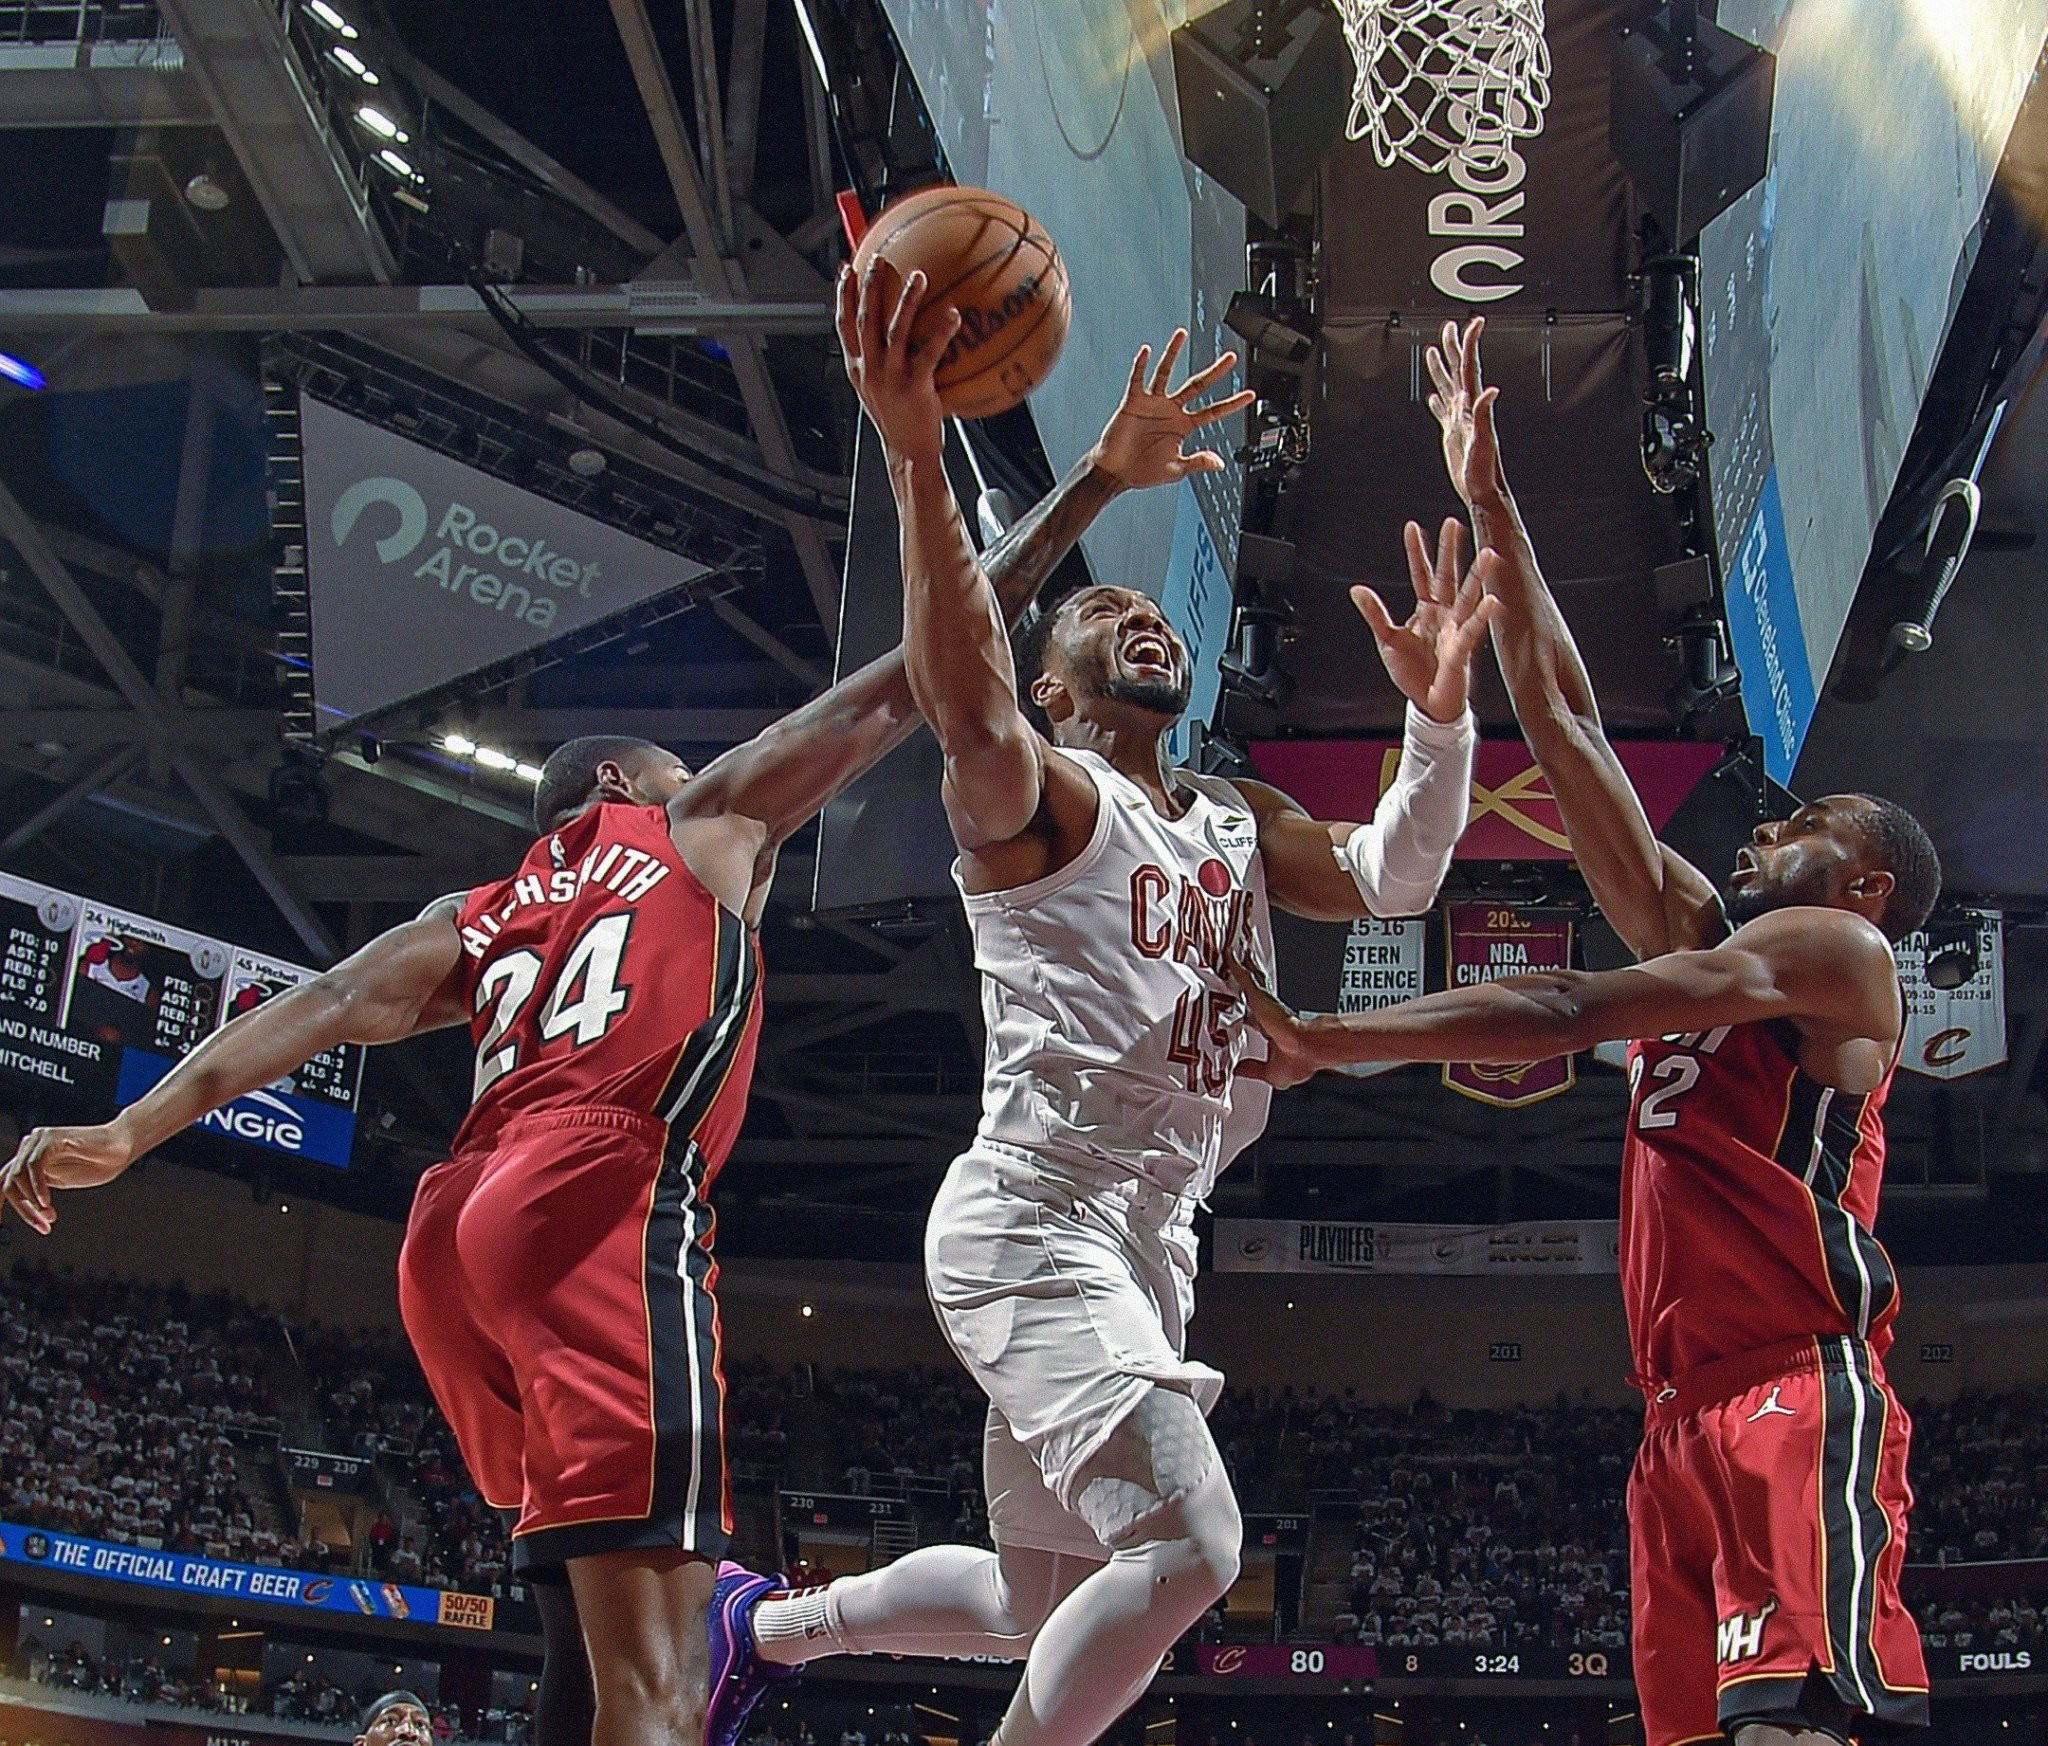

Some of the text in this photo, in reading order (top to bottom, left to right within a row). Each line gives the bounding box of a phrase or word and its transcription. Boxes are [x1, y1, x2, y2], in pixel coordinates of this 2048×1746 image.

[436, 502, 601, 599] Rocket
[414, 547, 558, 629] Arena
[1183, 520, 1214, 668] LIFFS
[462, 843, 671, 960] HIHSITH
[1487, 911, 1531, 929] 201
[1345, 945, 1401, 965] STERN
[1490, 943, 1529, 964] NBA
[1341, 969, 1418, 989] FERENCE
[473, 914, 632, 1100] 24
[29, 1026, 101, 1062] NUMBER
[1301, 1225, 1374, 1262] PLAYOFFS
[1490, 1346, 1520, 1360] 201
[1923, 1346, 1951, 1360] 202
[54, 1540, 90, 1567] THE
[93, 1548, 175, 1582] OFFICIAL
[182, 1564, 247, 1591] CRAFT
[250, 1573, 300, 1599] BEER
[445, 1594, 488, 1614] 50/50
[444, 1611, 487, 1627] RAFFLE
[1291, 1650, 1608, 1676] 80 8 3:24 3Q
[1959, 1651, 2031, 1672] FOULS
